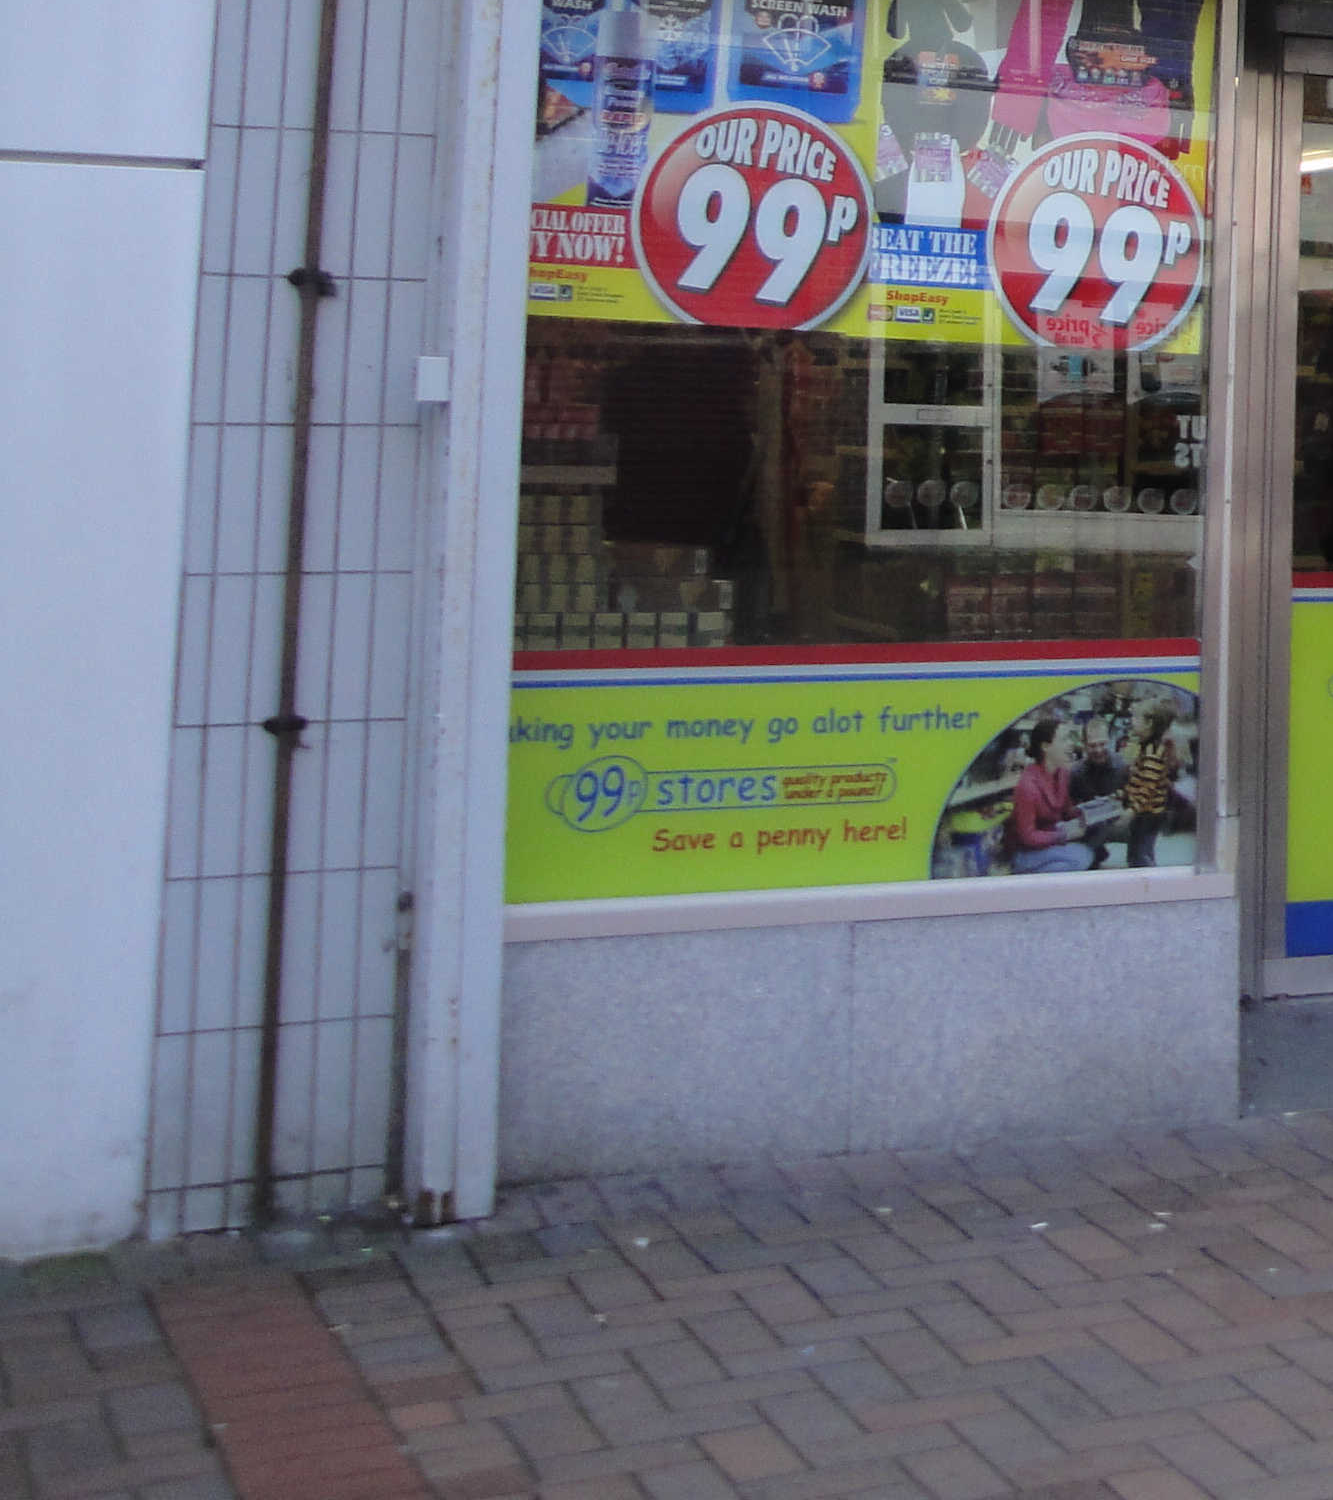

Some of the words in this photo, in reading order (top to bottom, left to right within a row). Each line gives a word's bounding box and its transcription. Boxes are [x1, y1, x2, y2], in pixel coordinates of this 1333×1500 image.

[807, 2, 849, 18] WASH
[695, 118, 760, 167] OUR
[759, 119, 838, 183] PRICE
[1043, 148, 1097, 198] OUR
[1101, 149, 1170, 209] PRICE
[570, 211, 626, 235] OFFER
[676, 162, 859, 307] 99p
[555, 232, 625, 263] NOW!
[928, 230, 978, 256] THE
[1028, 191, 1190, 327] 99p
[886, 289, 950, 306] ShopEasy
[588, 720, 653, 750] your
[665, 718, 755, 745] money
[767, 716, 799, 744] go
[812, 708, 864, 735] alot
[879, 704, 981, 734] further
[656, 773, 777, 806] stores
[829, 771, 888, 787] products
[651, 828, 716, 853] Save
[729, 831, 744, 849] a
[757, 827, 832, 855] penny
[842, 816, 909, 843] here!
